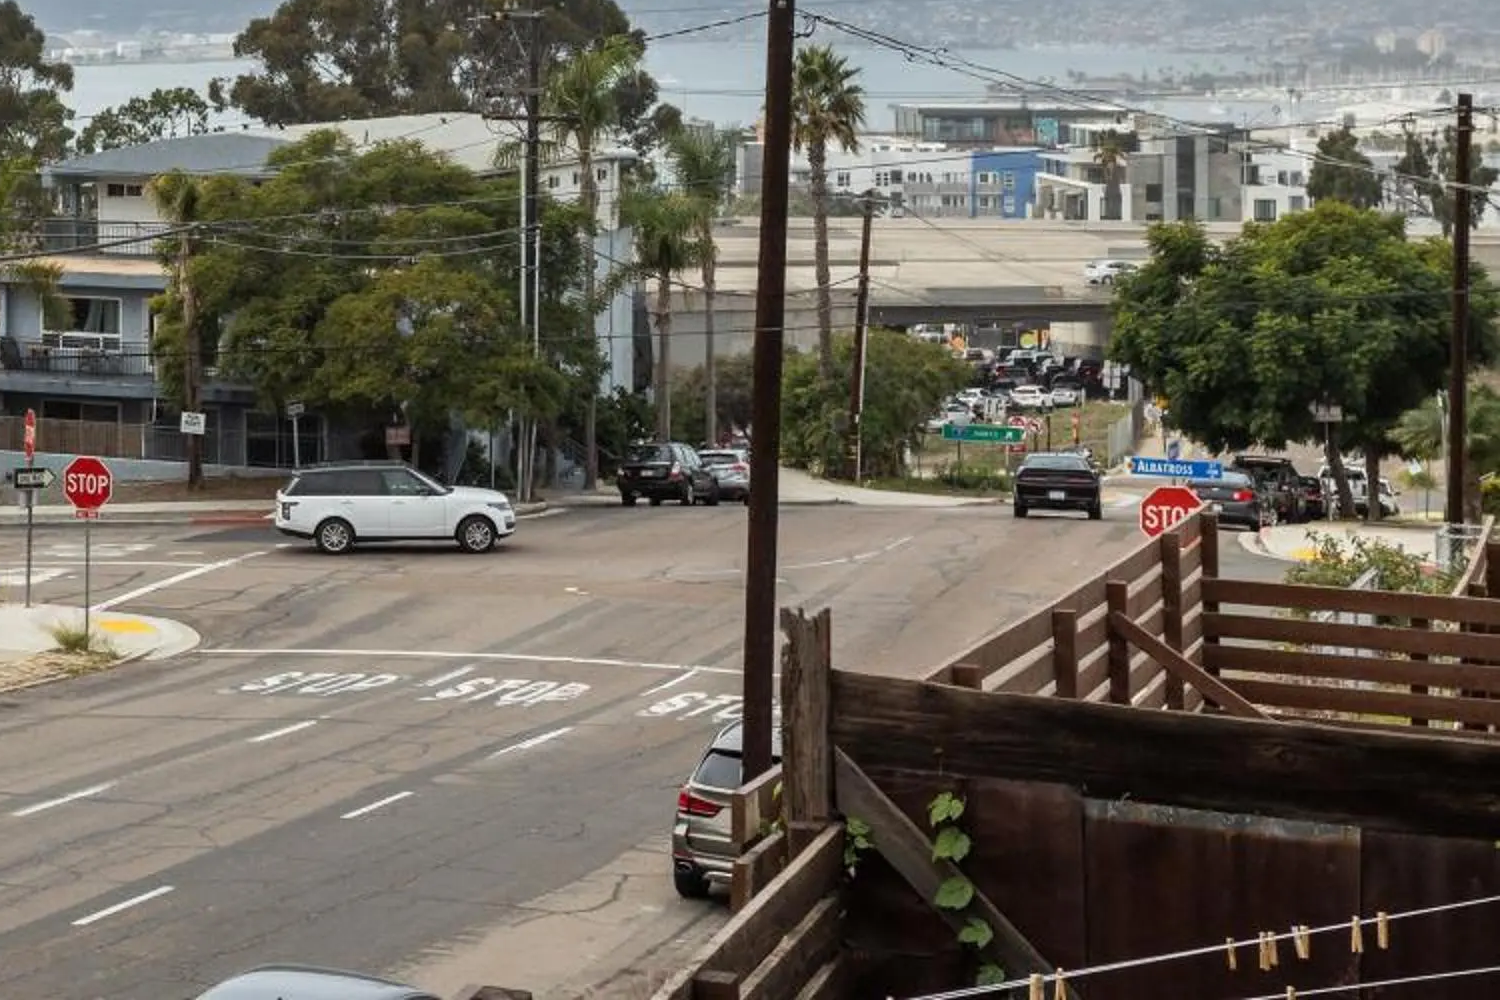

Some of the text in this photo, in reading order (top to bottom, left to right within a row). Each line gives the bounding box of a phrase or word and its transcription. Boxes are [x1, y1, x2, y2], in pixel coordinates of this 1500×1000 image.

[67, 473, 109, 494] STOP
[1145, 505, 1195, 528] STO
[232, 671, 399, 697] STOP
[417, 677, 591, 707] STOP
